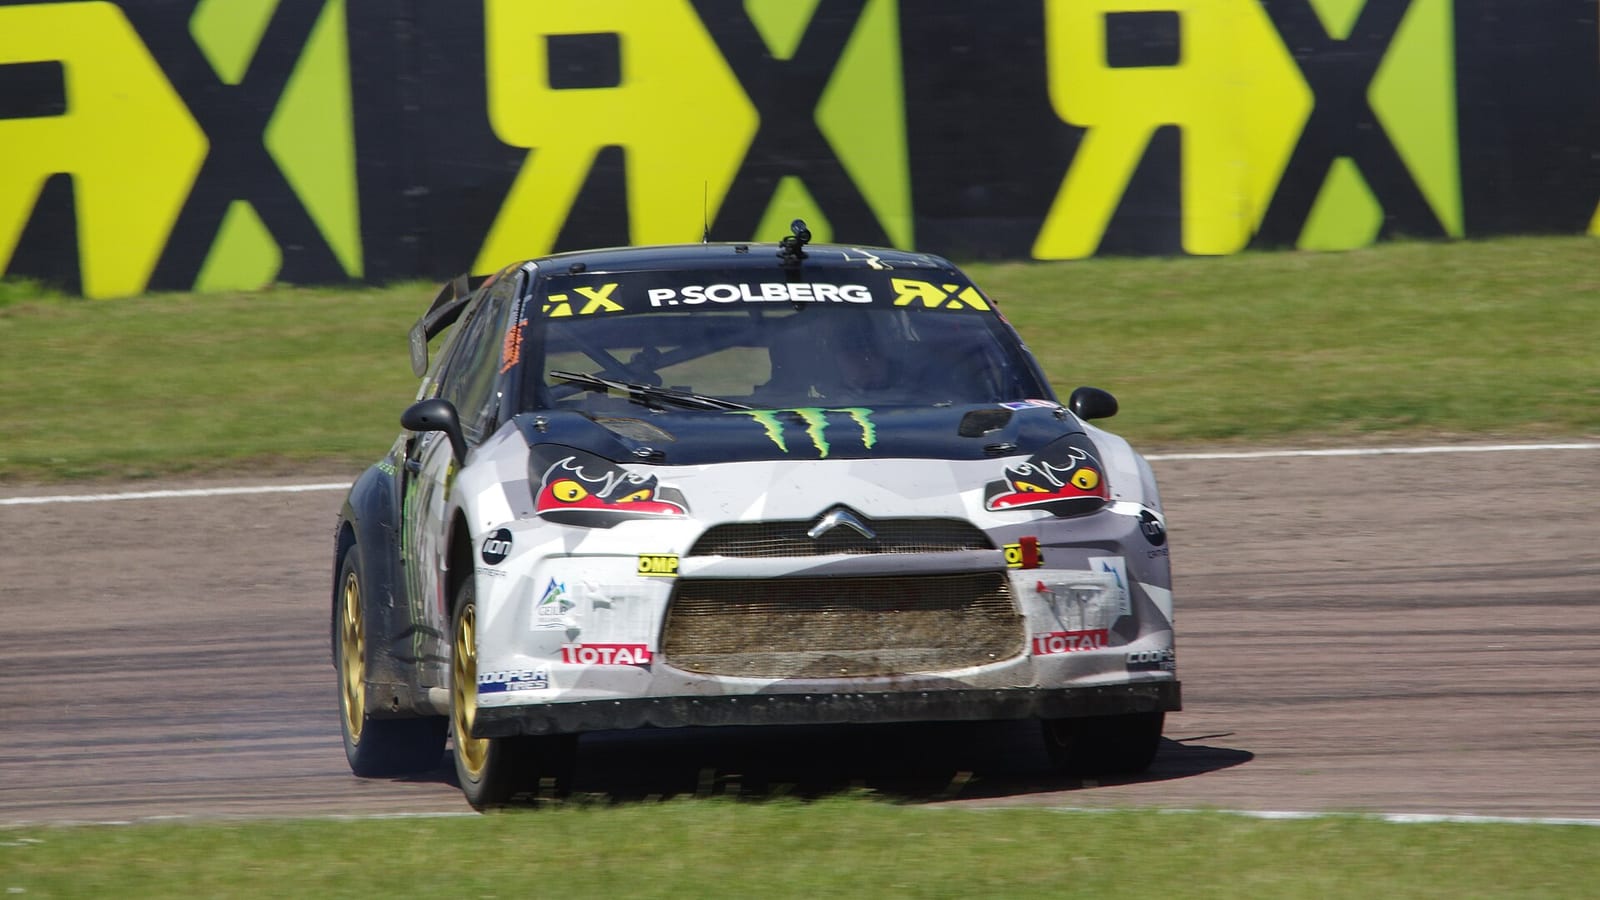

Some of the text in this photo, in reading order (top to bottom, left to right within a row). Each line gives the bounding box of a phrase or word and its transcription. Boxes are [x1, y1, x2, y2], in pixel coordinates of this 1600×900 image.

[482, 530, 512, 556] ion
[638, 556, 678, 573] OMP
[562, 643, 649, 664] TOTAL
[1033, 632, 1105, 654] TOTAL
